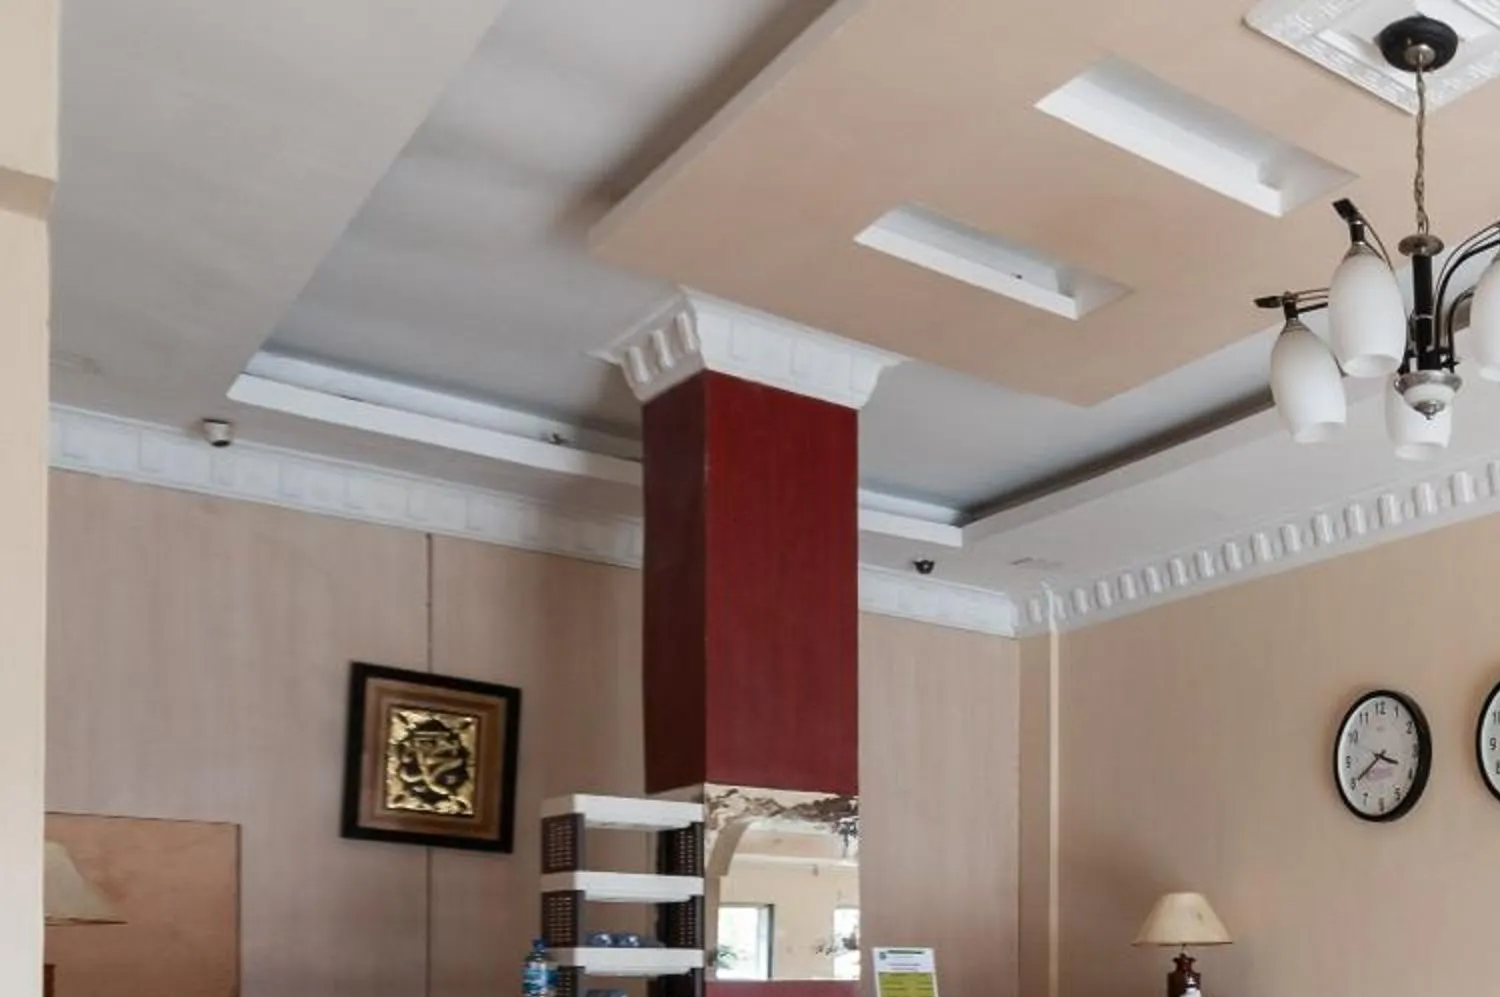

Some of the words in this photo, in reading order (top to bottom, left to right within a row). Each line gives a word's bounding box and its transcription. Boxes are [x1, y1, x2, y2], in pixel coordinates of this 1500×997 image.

[1375, 701, 1386, 715] 12
[1394, 706, 1398, 718] 1
[1359, 712, 1369, 725] 11
[1348, 730, 1358, 744] 10
[1490, 738, 1496, 750] 9
